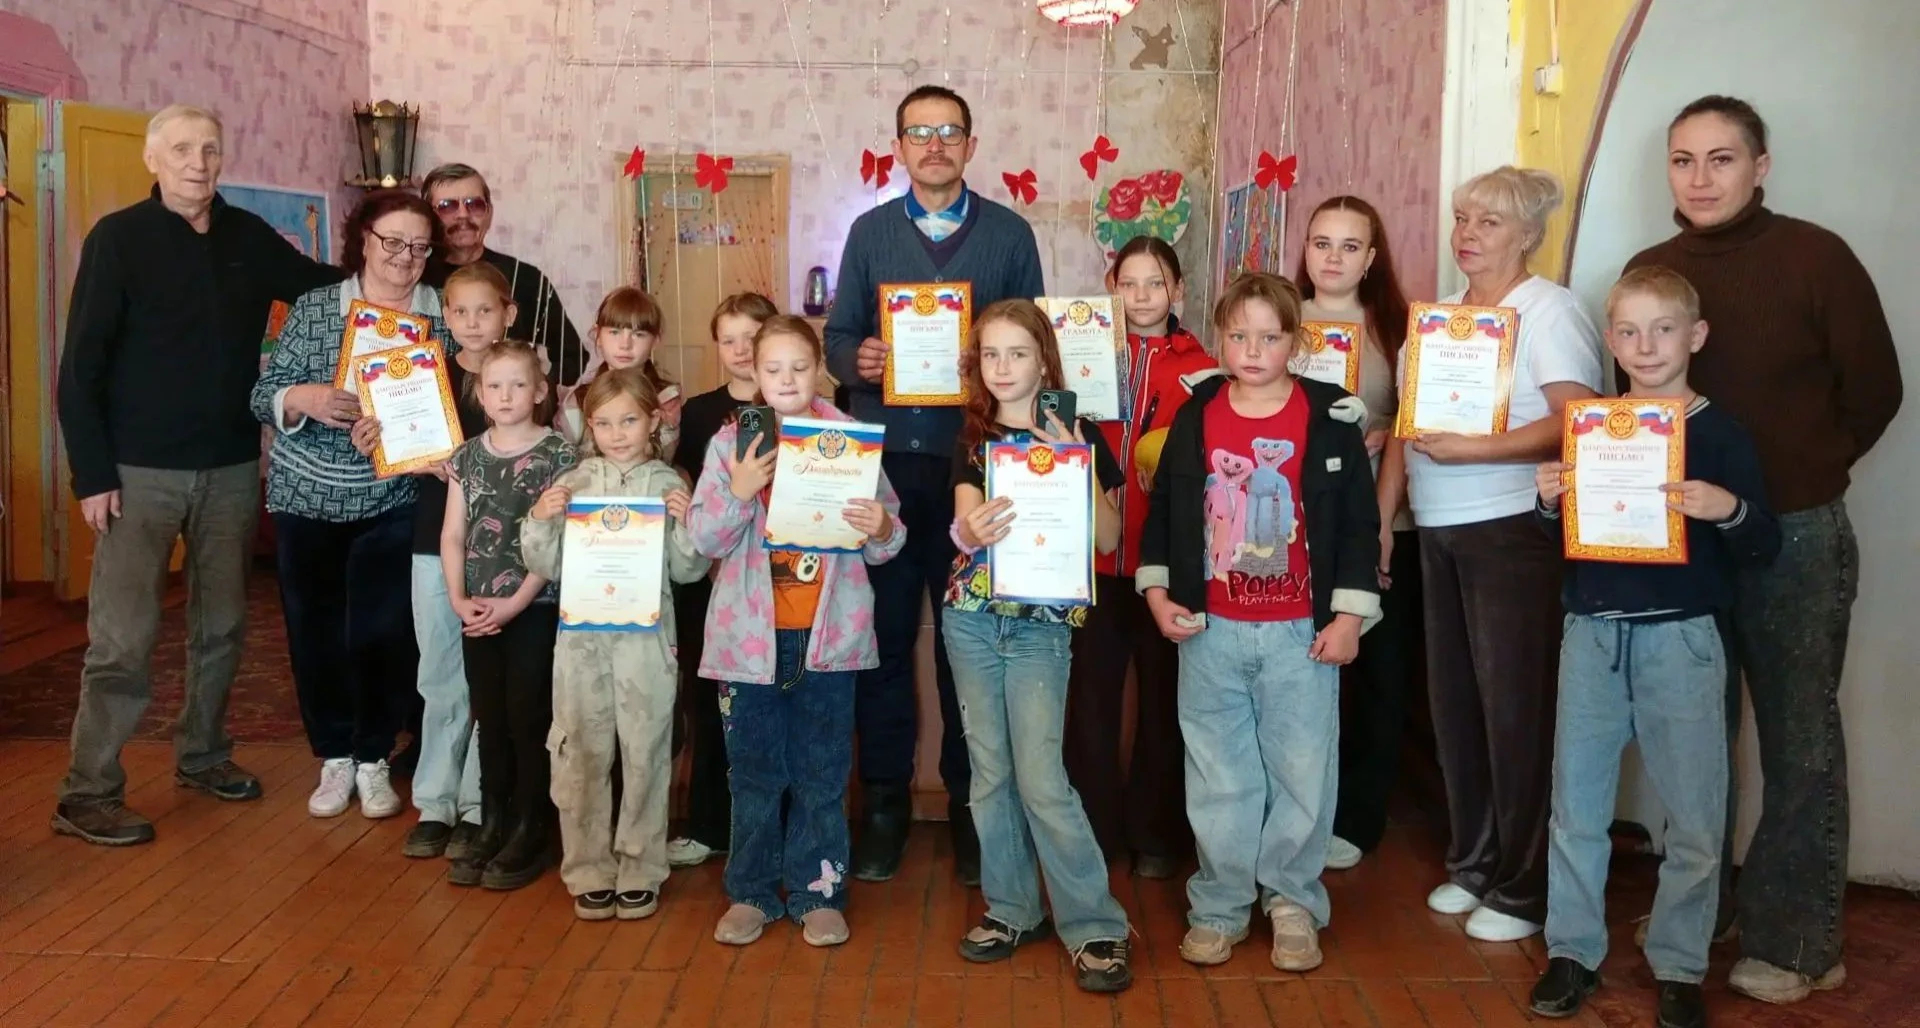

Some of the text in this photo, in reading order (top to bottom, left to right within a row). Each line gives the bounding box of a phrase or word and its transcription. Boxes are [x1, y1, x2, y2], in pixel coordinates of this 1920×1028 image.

[1439, 351, 1479, 360] ПИСЬМО
[1598, 453, 1645, 461] ПИСЬМО
[1226, 570, 1309, 602] POPPY
